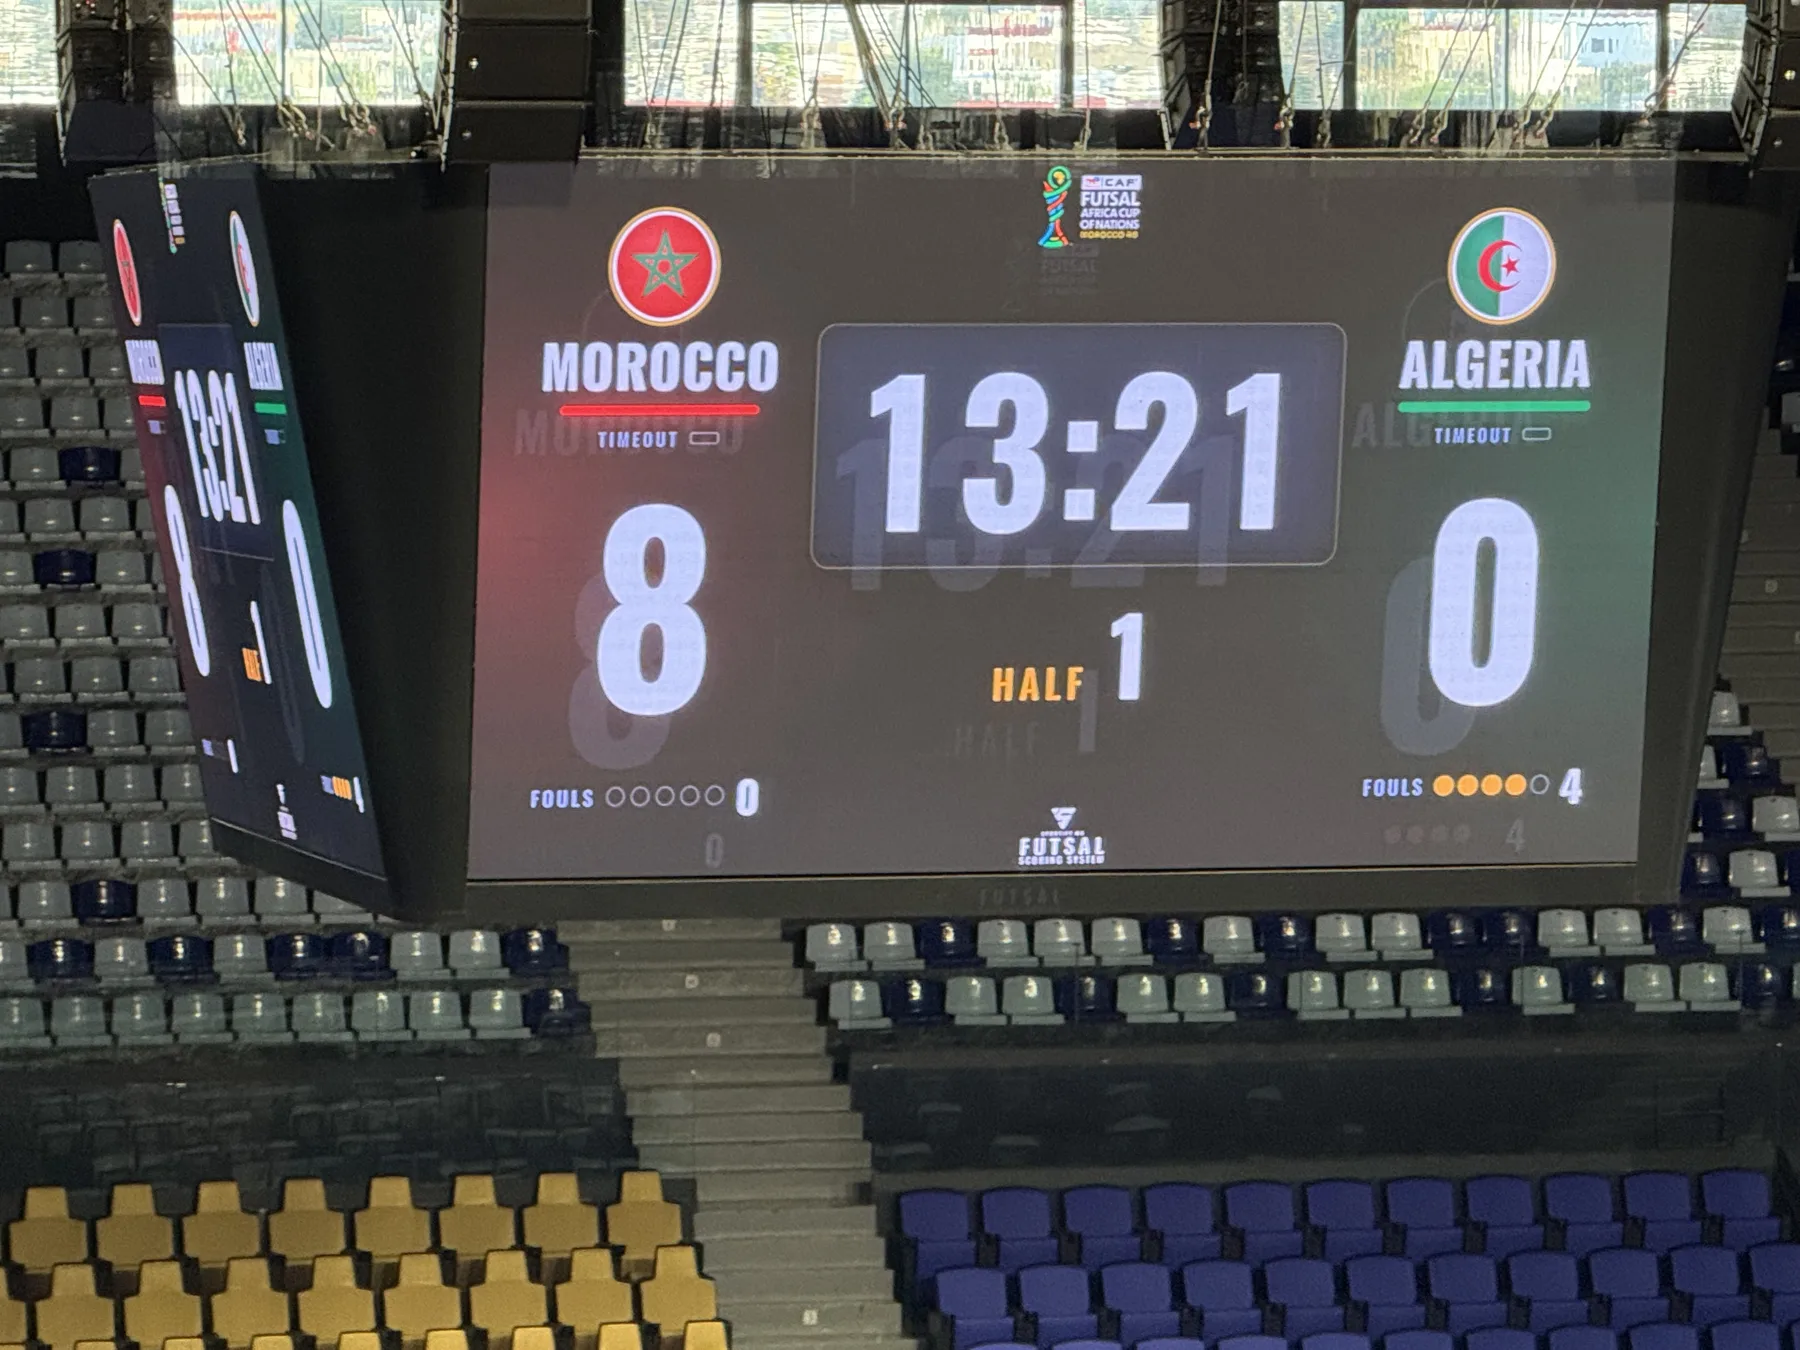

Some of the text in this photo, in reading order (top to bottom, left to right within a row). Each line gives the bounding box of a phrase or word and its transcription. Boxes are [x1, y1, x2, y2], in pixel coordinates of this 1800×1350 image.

[1080, 191, 1141, 207] FUTSAL
[1104, 178, 1136, 187] CAF
[1079, 219, 1140, 230] OF NATIONS
[1080, 208, 1141, 218] AFRICA CUP
[542, 341, 778, 392] MOROCCO
[1399, 340, 1590, 389] ALGERIA
[175, 369, 261, 524] 13:21
[598, 431, 678, 448] TIMEOUT
[871, 372, 1280, 534] 13:21
[1434, 427, 1512, 444] TIMEOUT
[597, 504, 706, 715] 8
[1429, 498, 1538, 706] 0
[992, 612, 1143, 701] HALF 1
[530, 778, 759, 816] FOULS 0
[1362, 768, 1583, 804] FOULS 4
[1018, 837, 1105, 856] FUTSAL
[1018, 855, 1105, 865] SCORING SYSTEM
